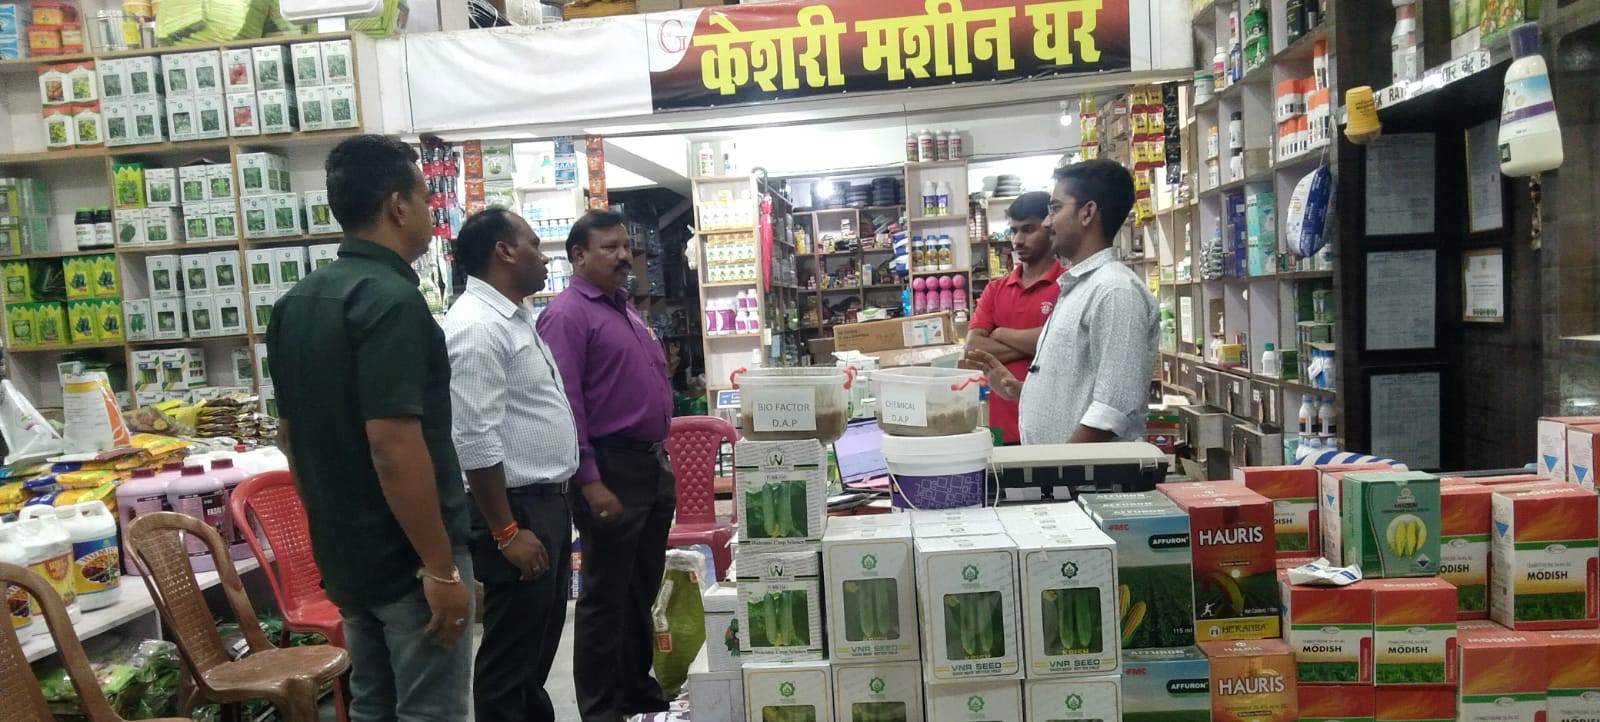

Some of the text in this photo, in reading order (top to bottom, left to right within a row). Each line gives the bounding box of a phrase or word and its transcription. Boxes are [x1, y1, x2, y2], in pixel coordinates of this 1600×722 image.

[692, 0, 1103, 96] केशरी मशीन घर
[758, 402, 810, 412] BIO FACTOR
[885, 401, 916, 411] CHEMICAL
[772, 418, 798, 428] D.A.P
[891, 414, 910, 423] D.A.P
[1273, 517, 1293, 525] DISH
[1152, 535, 1187, 545] AFFURON
[1199, 526, 1264, 546] HAURIS
[1440, 564, 1470, 574] ODISH
[1527, 571, 1568, 581] MODISH
[1302, 645, 1342, 653] MODISH
[1388, 646, 1428, 654] MODISH
[951, 662, 1002, 672] VNR SEED
[1049, 658, 1101, 668] VNR SEED
[1171, 681, 1208, 690] AFFURON
[1218, 676, 1286, 696] HAURIS
